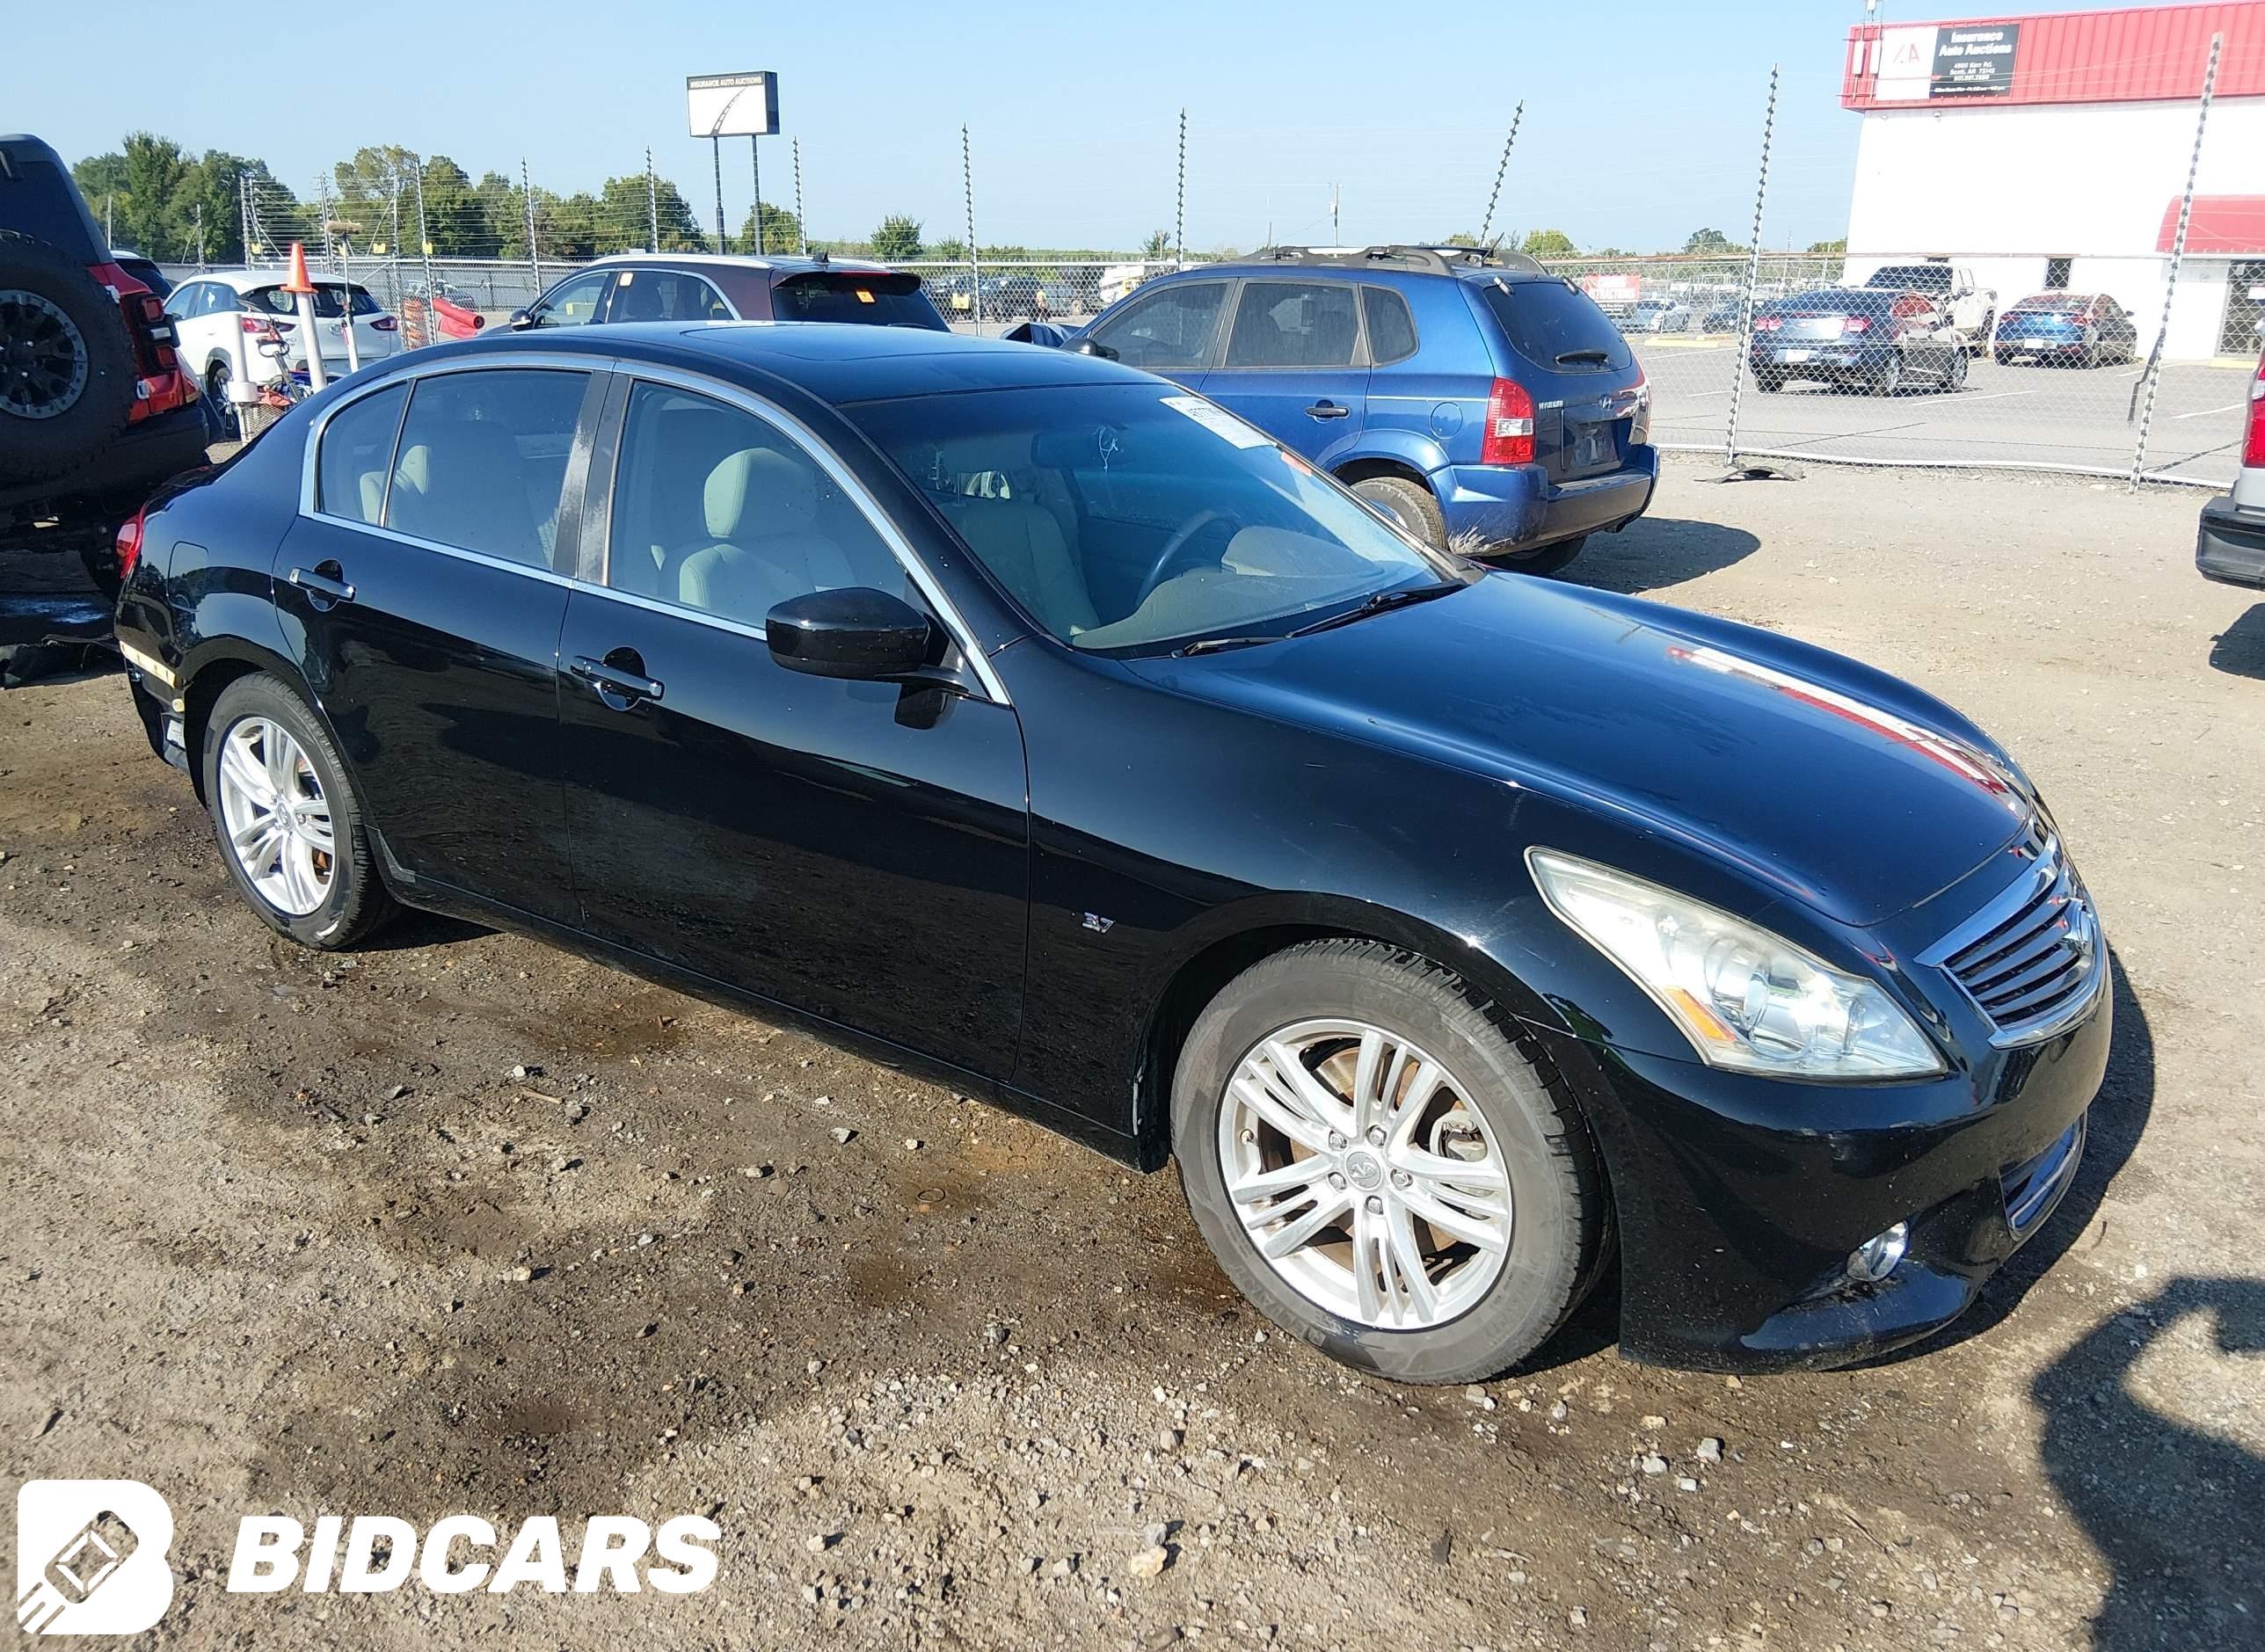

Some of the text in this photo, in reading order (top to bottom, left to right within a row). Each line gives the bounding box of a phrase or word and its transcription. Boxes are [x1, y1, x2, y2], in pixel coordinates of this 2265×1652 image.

[1939, 42, 2012, 56] Auto Auctions
[720, 77, 734, 86] AUTO
